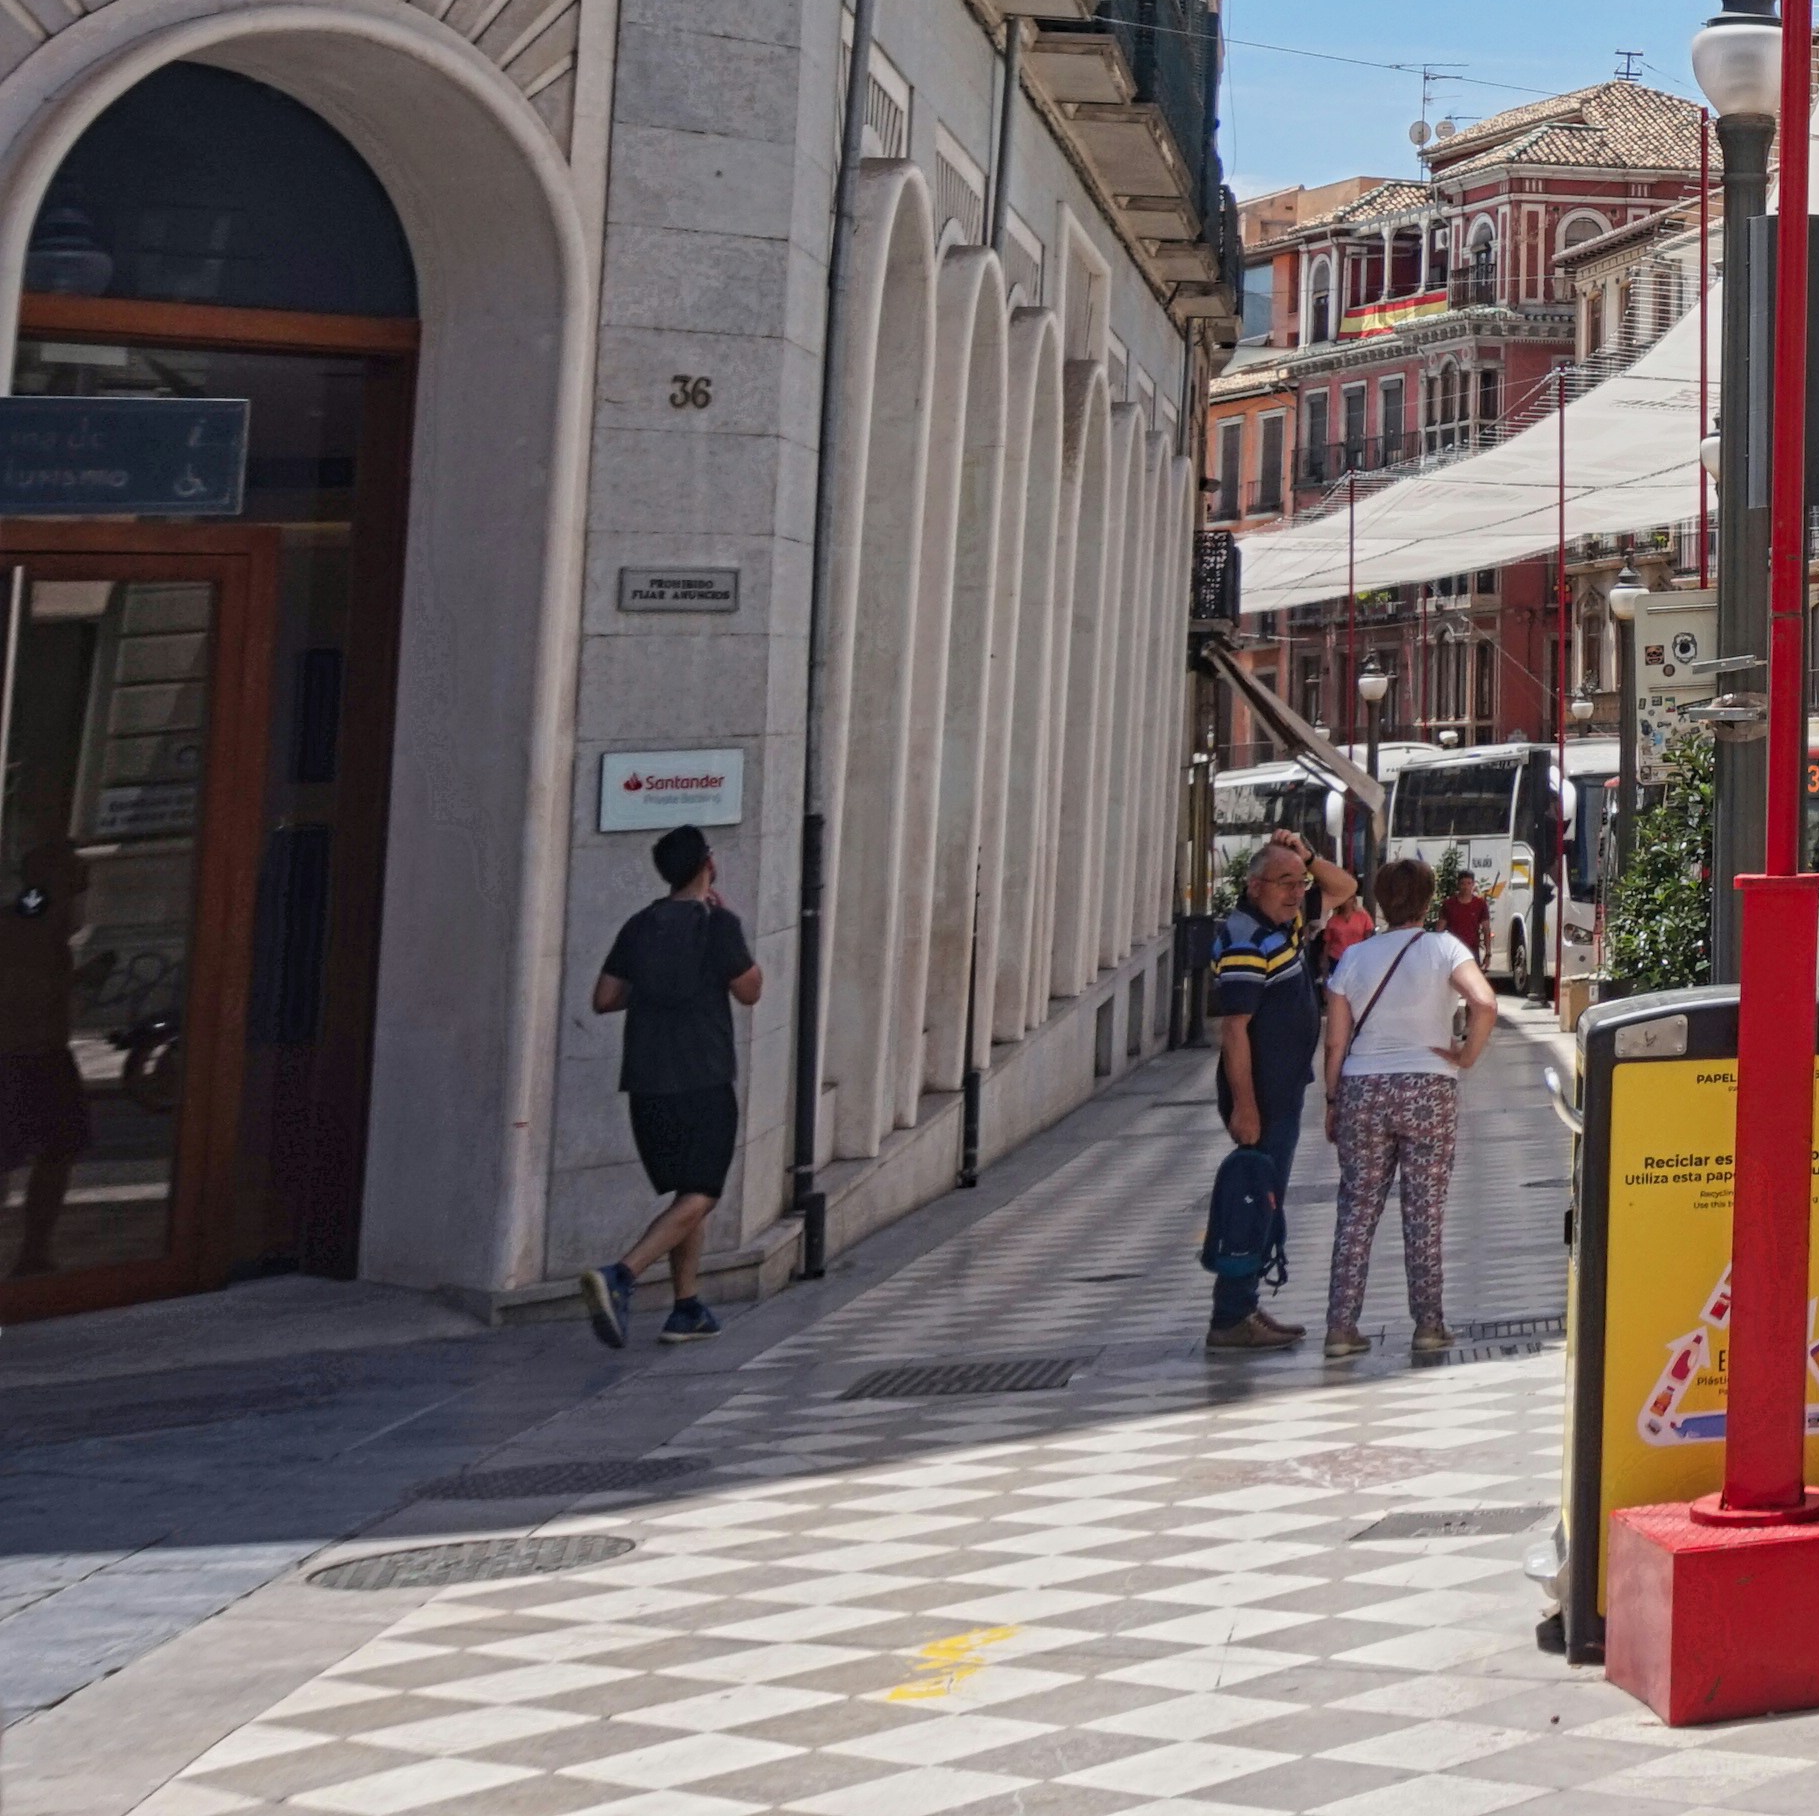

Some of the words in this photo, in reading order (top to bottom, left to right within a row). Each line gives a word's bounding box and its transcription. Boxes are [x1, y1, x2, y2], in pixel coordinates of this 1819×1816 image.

[669, 374, 712, 409] 36
[650, 579, 714, 590] PROHIBIDO
[631, 590, 665, 601] FIJAR
[672, 590, 731, 601] ANUNCIOS
[645, 775, 725, 790] Santander
[1696, 1073, 1737, 1085] PAPEL
[1644, 1153, 1710, 1169] Reciclar
[1715, 1155, 1734, 1167] es
[1625, 1171, 1668, 1186] Utiliza
[1673, 1172, 1702, 1184] esta
[1700, 1190, 1735, 1199] Recyclin
